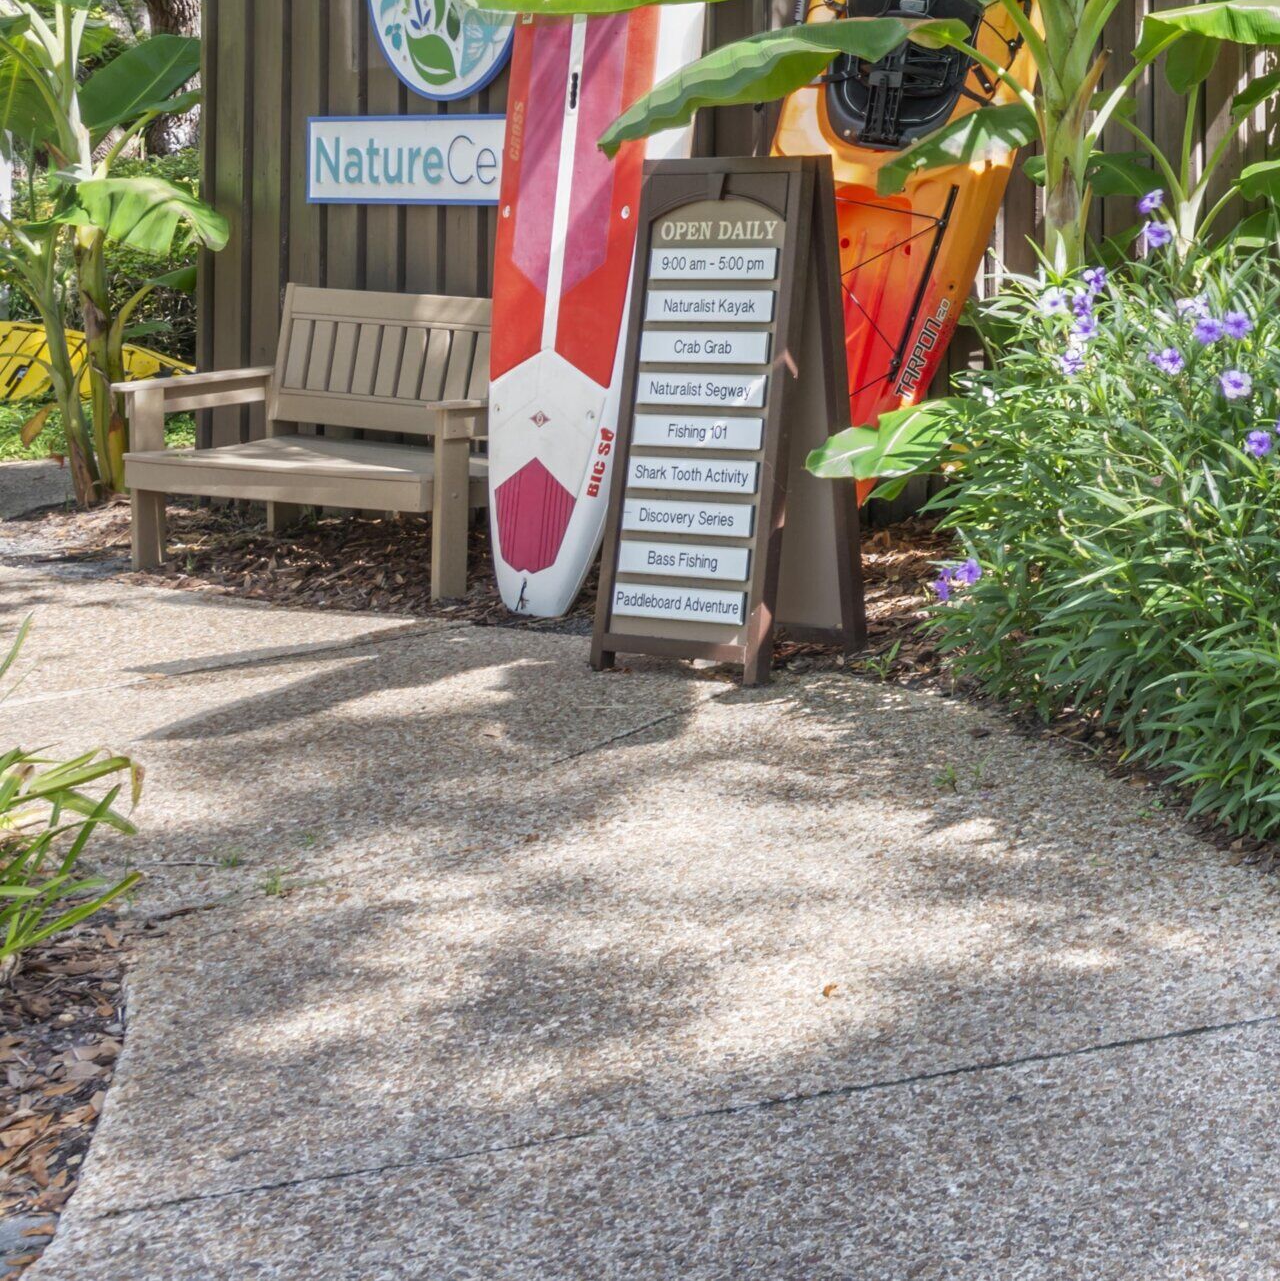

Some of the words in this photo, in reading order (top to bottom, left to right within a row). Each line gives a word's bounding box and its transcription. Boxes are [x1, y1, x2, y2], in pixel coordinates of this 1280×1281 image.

[661, 221, 713, 240] OPEN
[718, 221, 778, 239] DAILY
[662, 256, 687, 270] 9:00
[689, 260, 706, 270] am
[718, 256, 744, 270] 5:00
[747, 260, 764, 273] pm
[663, 299, 715, 313] Naturalist
[719, 299, 755, 315] Kayak
[674, 339, 701, 354] Crab
[704, 340, 732, 354] Grab
[895, 317, 942, 399] TARPON
[650, 381, 702, 396] Naturalist
[705, 383, 751, 400] Segway
[668, 423, 706, 441] Fishing
[710, 425, 727, 439] 101
[586, 460, 606, 497] BIC
[635, 464, 667, 479] Shark
[671, 466, 702, 481] Tooth
[704, 468, 749, 487] Activity
[639, 507, 695, 527] Discovery
[698, 511, 734, 527] Series
[647, 550, 676, 566] Bass
[678, 552, 718, 572] Fishing
[616, 591, 682, 610] Paddleboard
[684, 596, 739, 615] Adventure
